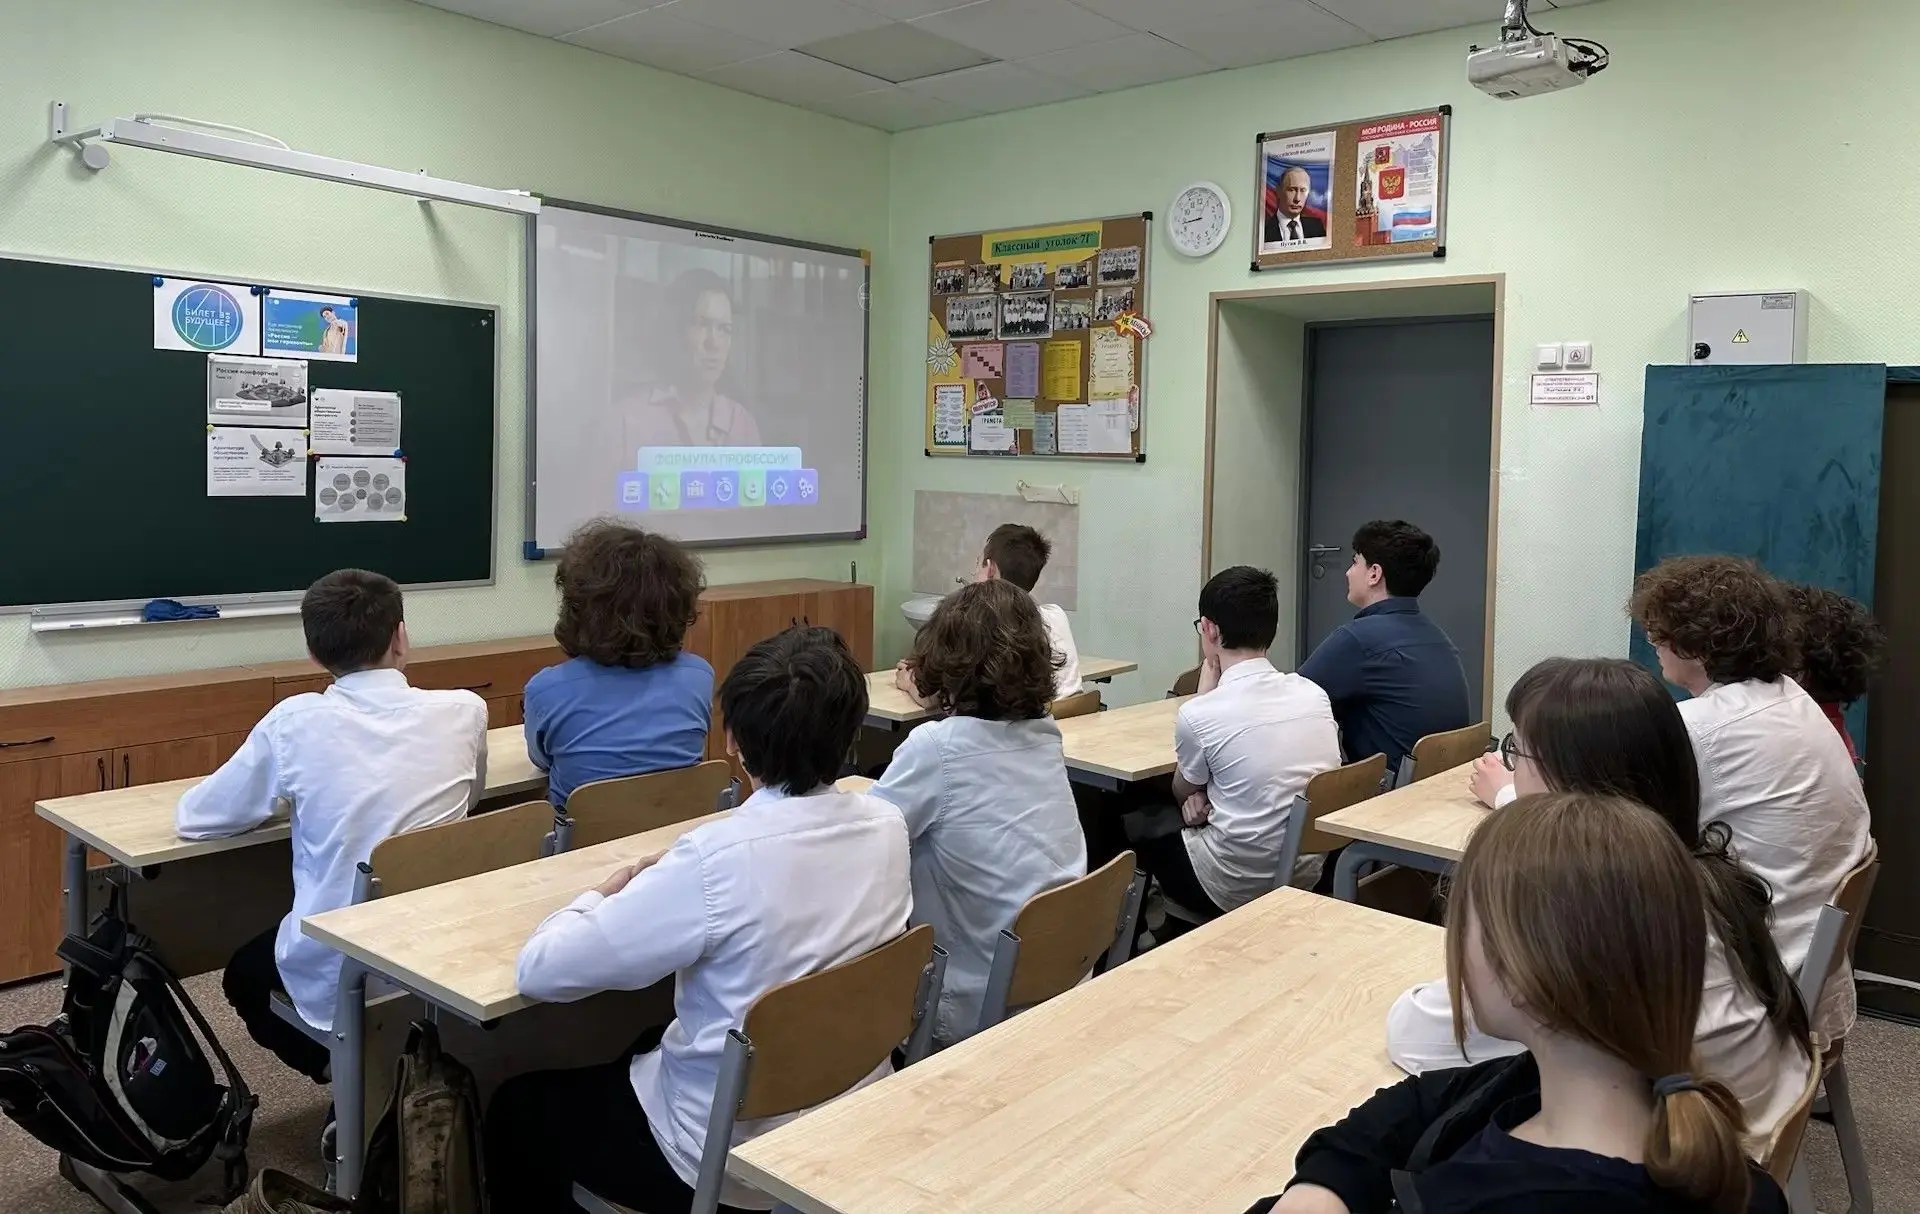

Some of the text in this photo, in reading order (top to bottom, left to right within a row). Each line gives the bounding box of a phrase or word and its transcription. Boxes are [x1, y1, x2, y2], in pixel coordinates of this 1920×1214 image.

[1361, 126, 1376, 136] МОЯ
[1377, 122, 1405, 134] РОДИНА
[1409, 117, 1437, 129] РОССИЯ
[995, 240, 1040, 253] Классный
[1045, 237, 1077, 251] уголок
[185, 308, 225, 319] БИЛЕТ В
[185, 316, 225, 327] БУДУЩЕЕ
[1121, 316, 1131, 326] НЕ
[216, 366, 239, 375] Россия
[655, 452, 716, 466] ФОРМУЛА
